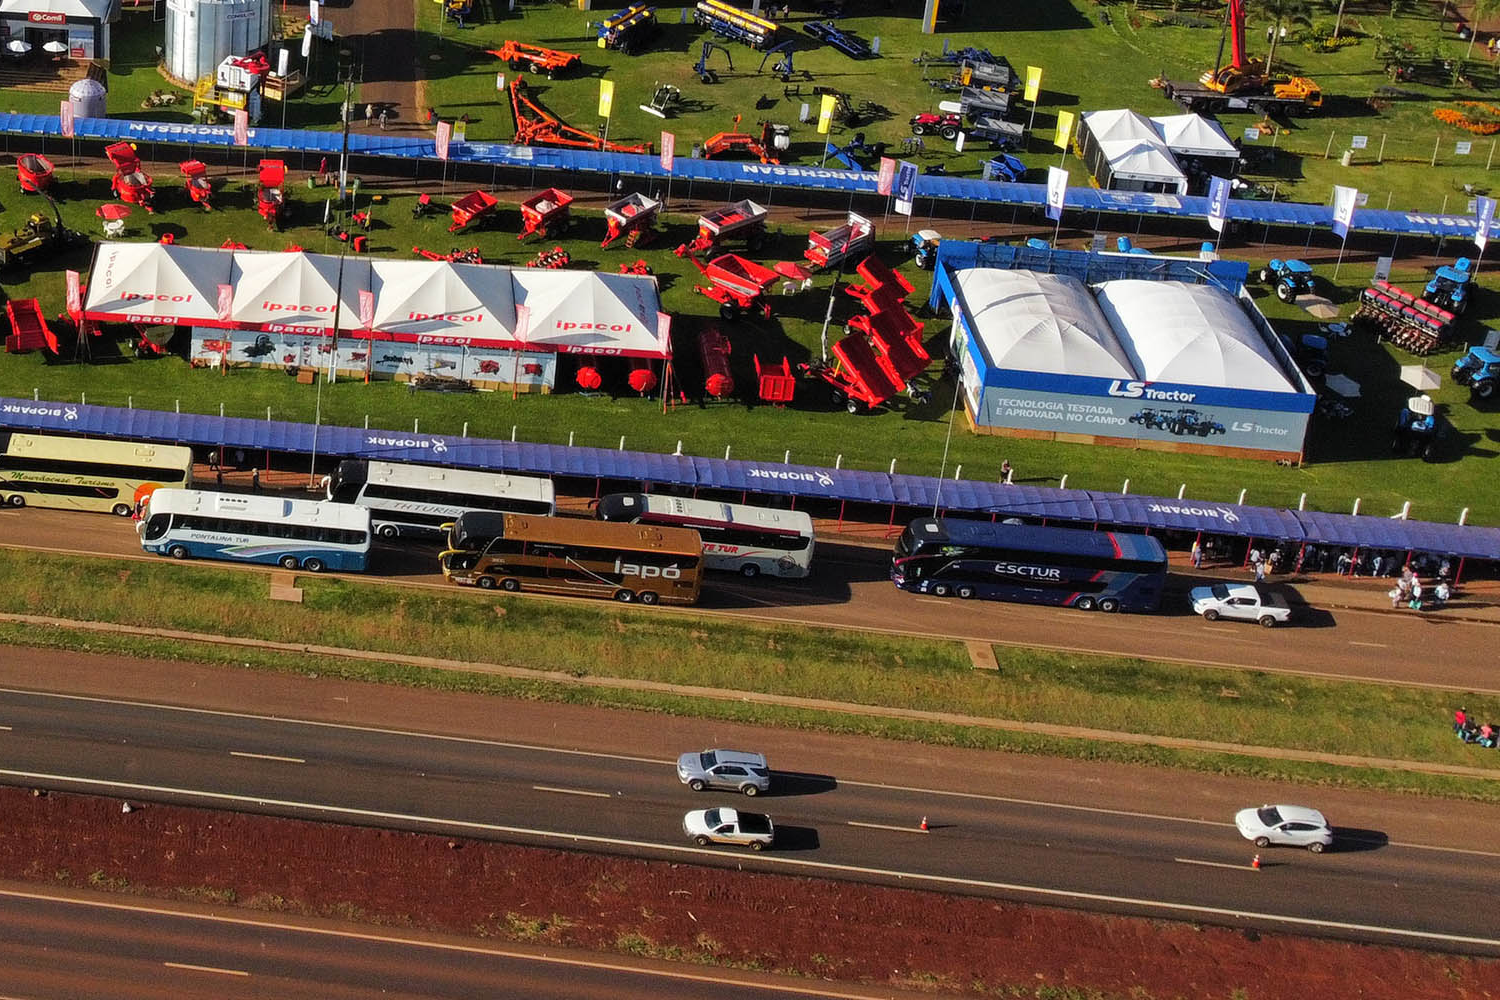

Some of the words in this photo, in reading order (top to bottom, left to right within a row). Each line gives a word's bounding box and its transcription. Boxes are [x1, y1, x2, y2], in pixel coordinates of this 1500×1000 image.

[42, 13, 62, 22] Comil
[742, 165, 880, 183] MARCHESAN
[120, 290, 192, 303] ipacol
[262, 300, 337, 314] ipacol
[126, 313, 178, 325] ipacol
[408, 311, 484, 323] ipacol
[268, 323, 324, 336] ipacol
[556, 319, 632, 333] ipacol
[417, 334, 472, 346] ipacol
[566, 344, 623, 356] ipacol
[1108, 380, 1145, 398] LS
[1145, 388, 1197, 403] Tractor
[3, 405, 62, 417] BIOPARK
[998, 398, 1065, 412] TECNOLOGIA
[1067, 404, 1114, 416] TESTADA
[996, 407, 1003, 415] E
[1005, 408, 1064, 421] APROVADA
[1067, 413, 1082, 423] NO
[1084, 415, 1126, 426] CAMPO
[1231, 421, 1253, 432] LS
[1254, 424, 1289, 436] Tractor
[368, 436, 430, 449] BIOPARK
[74, 476, 116, 487] Turismo
[748, 469, 815, 482] BIOPARK
[1149, 504, 1220, 518] BIOPARK
[718, 545, 739, 554] TUR
[995, 563, 1060, 578] ESCTUR
